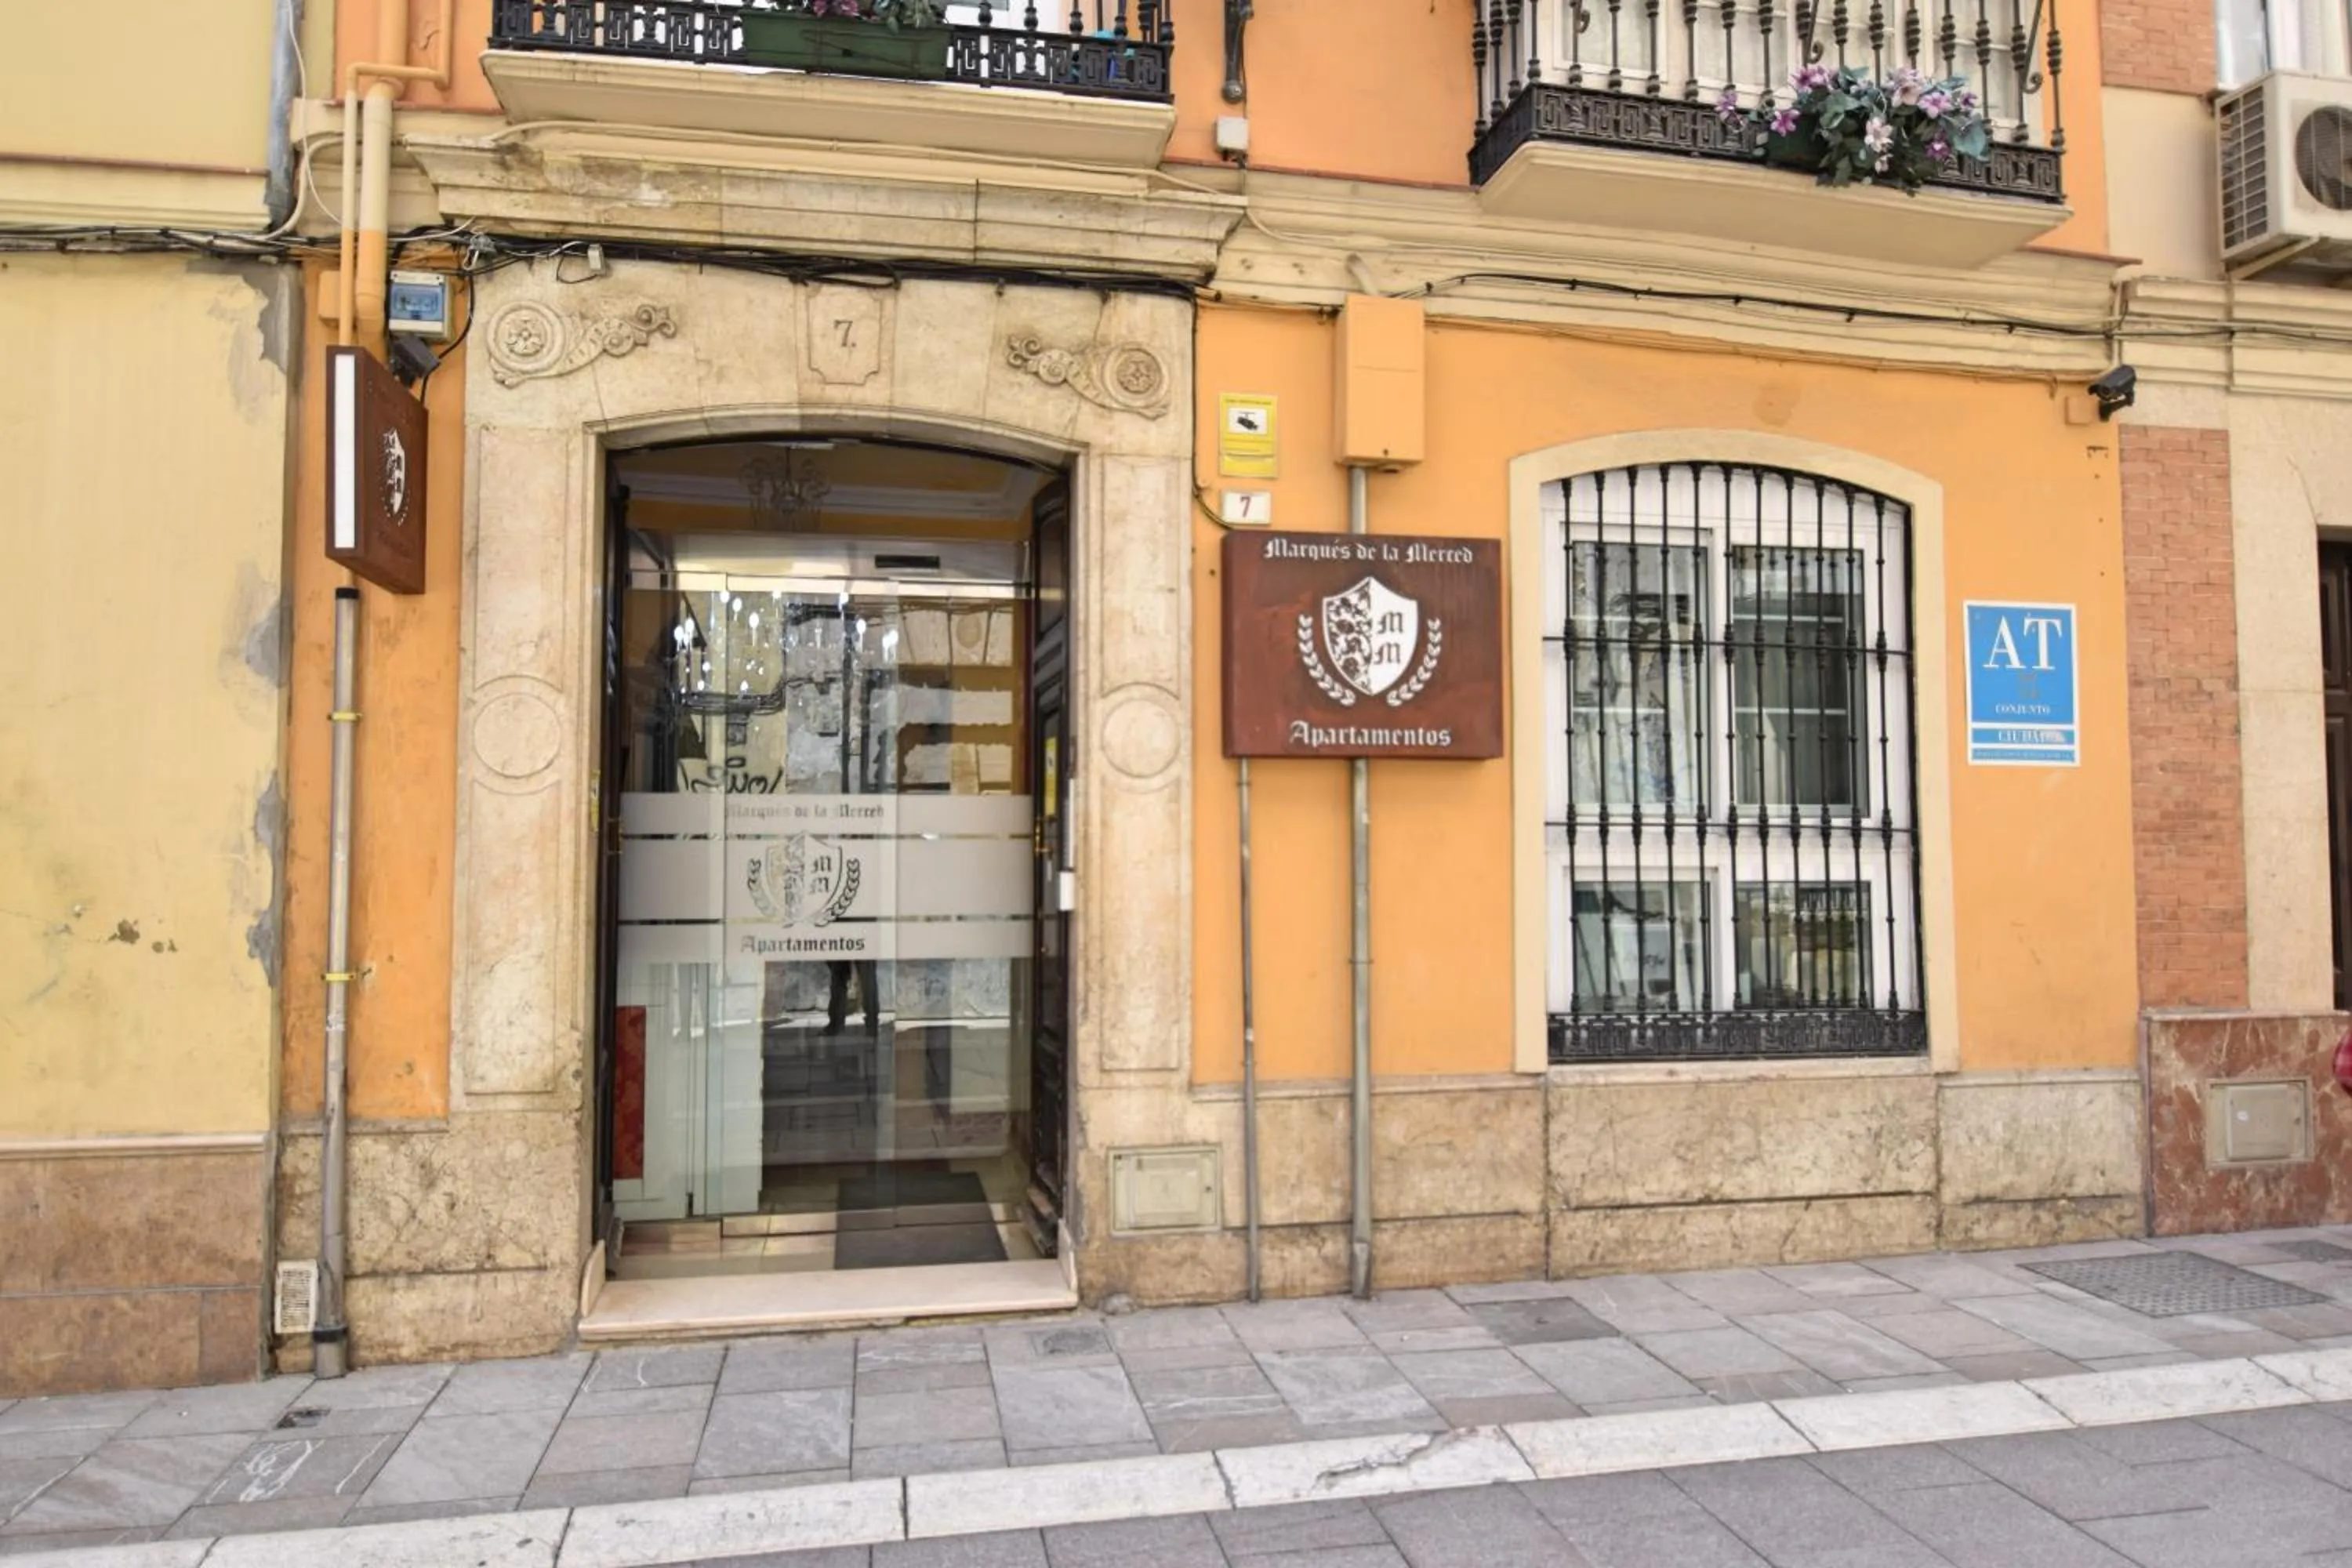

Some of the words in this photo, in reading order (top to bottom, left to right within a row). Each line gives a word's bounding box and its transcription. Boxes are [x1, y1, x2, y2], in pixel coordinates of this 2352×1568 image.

[1240, 495, 1251, 518] 7
[1264, 538, 1351, 560] Marqués
[1356, 543, 1376, 560] de
[1383, 544, 1399, 561] la
[1406, 546, 1473, 563] Merced
[1377, 612, 1403, 634] M
[1374, 642, 1401, 665] M
[1982, 615, 2063, 670] AT
[1995, 704, 2051, 715] CONJUNTO
[1289, 720, 1452, 747] Apartamentos
[741, 935, 865, 954] Apartamentos
